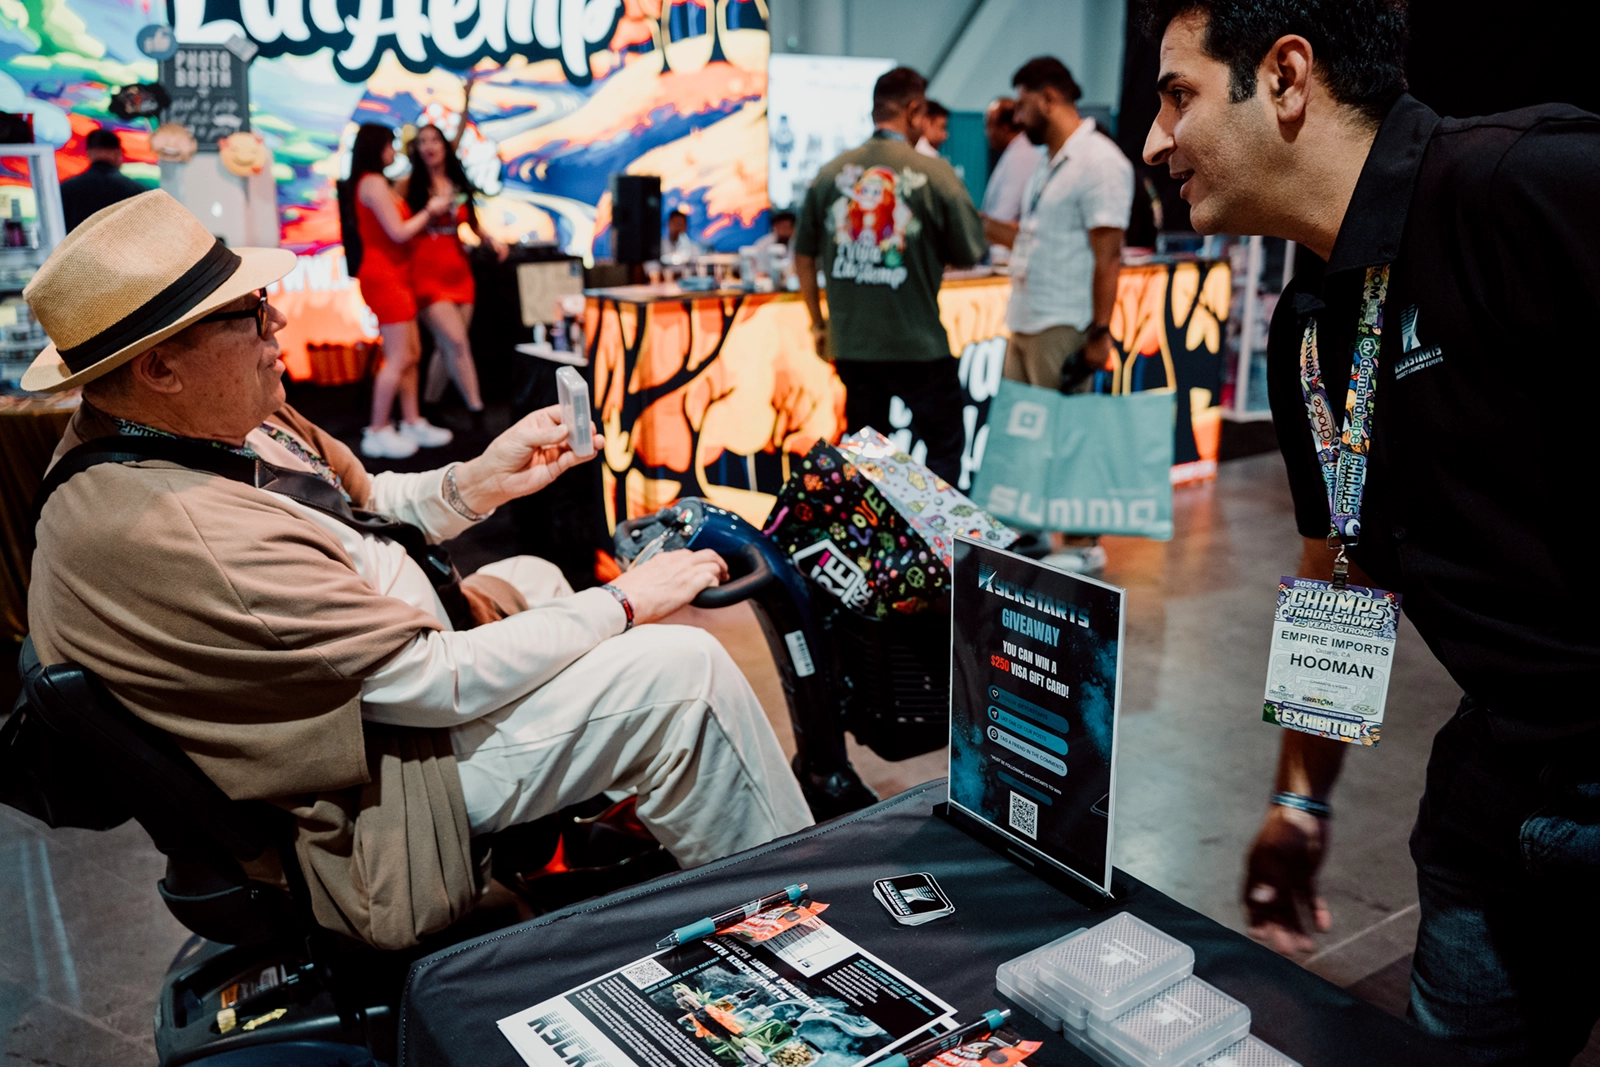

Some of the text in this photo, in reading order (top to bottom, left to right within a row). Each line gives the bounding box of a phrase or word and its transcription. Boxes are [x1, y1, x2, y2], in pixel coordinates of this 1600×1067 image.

[1314, 398, 1332, 440] choice
[1342, 455, 1365, 514] CHAMPS
[978, 563, 1090, 628] KYCKSTARTS
[1293, 580, 1319, 590] 2024
[1288, 607, 1384, 631] TRADE SHOWS
[1290, 587, 1389, 619] CHAMPS
[1002, 608, 1060, 647] GIVEAWAY
[1281, 630, 1328, 646] EMPIRE
[1331, 638, 1389, 656] IMPORTS
[1293, 619, 1374, 638] 25 YEARS STRONG
[1002, 640, 1057, 675] YOU CAN WIN A
[1290, 653, 1374, 679] HOOMAN
[991, 654, 1070, 699] $250 VISA GIFT CARD!
[1302, 696, 1334, 706] KRATOM
[1281, 708, 1361, 739] EXHIBITOR
[1000, 735, 1008, 743] TAG
[1012, 741, 1026, 752] FRIEND
[1040, 754, 1064, 772] COMMENTS
[716, 936, 752, 959] AUNCH
[749, 958, 779, 979] YOUR
[776, 977, 833, 1018] PRODUCTS
[726, 955, 790, 1001] KYCKSTARTS
